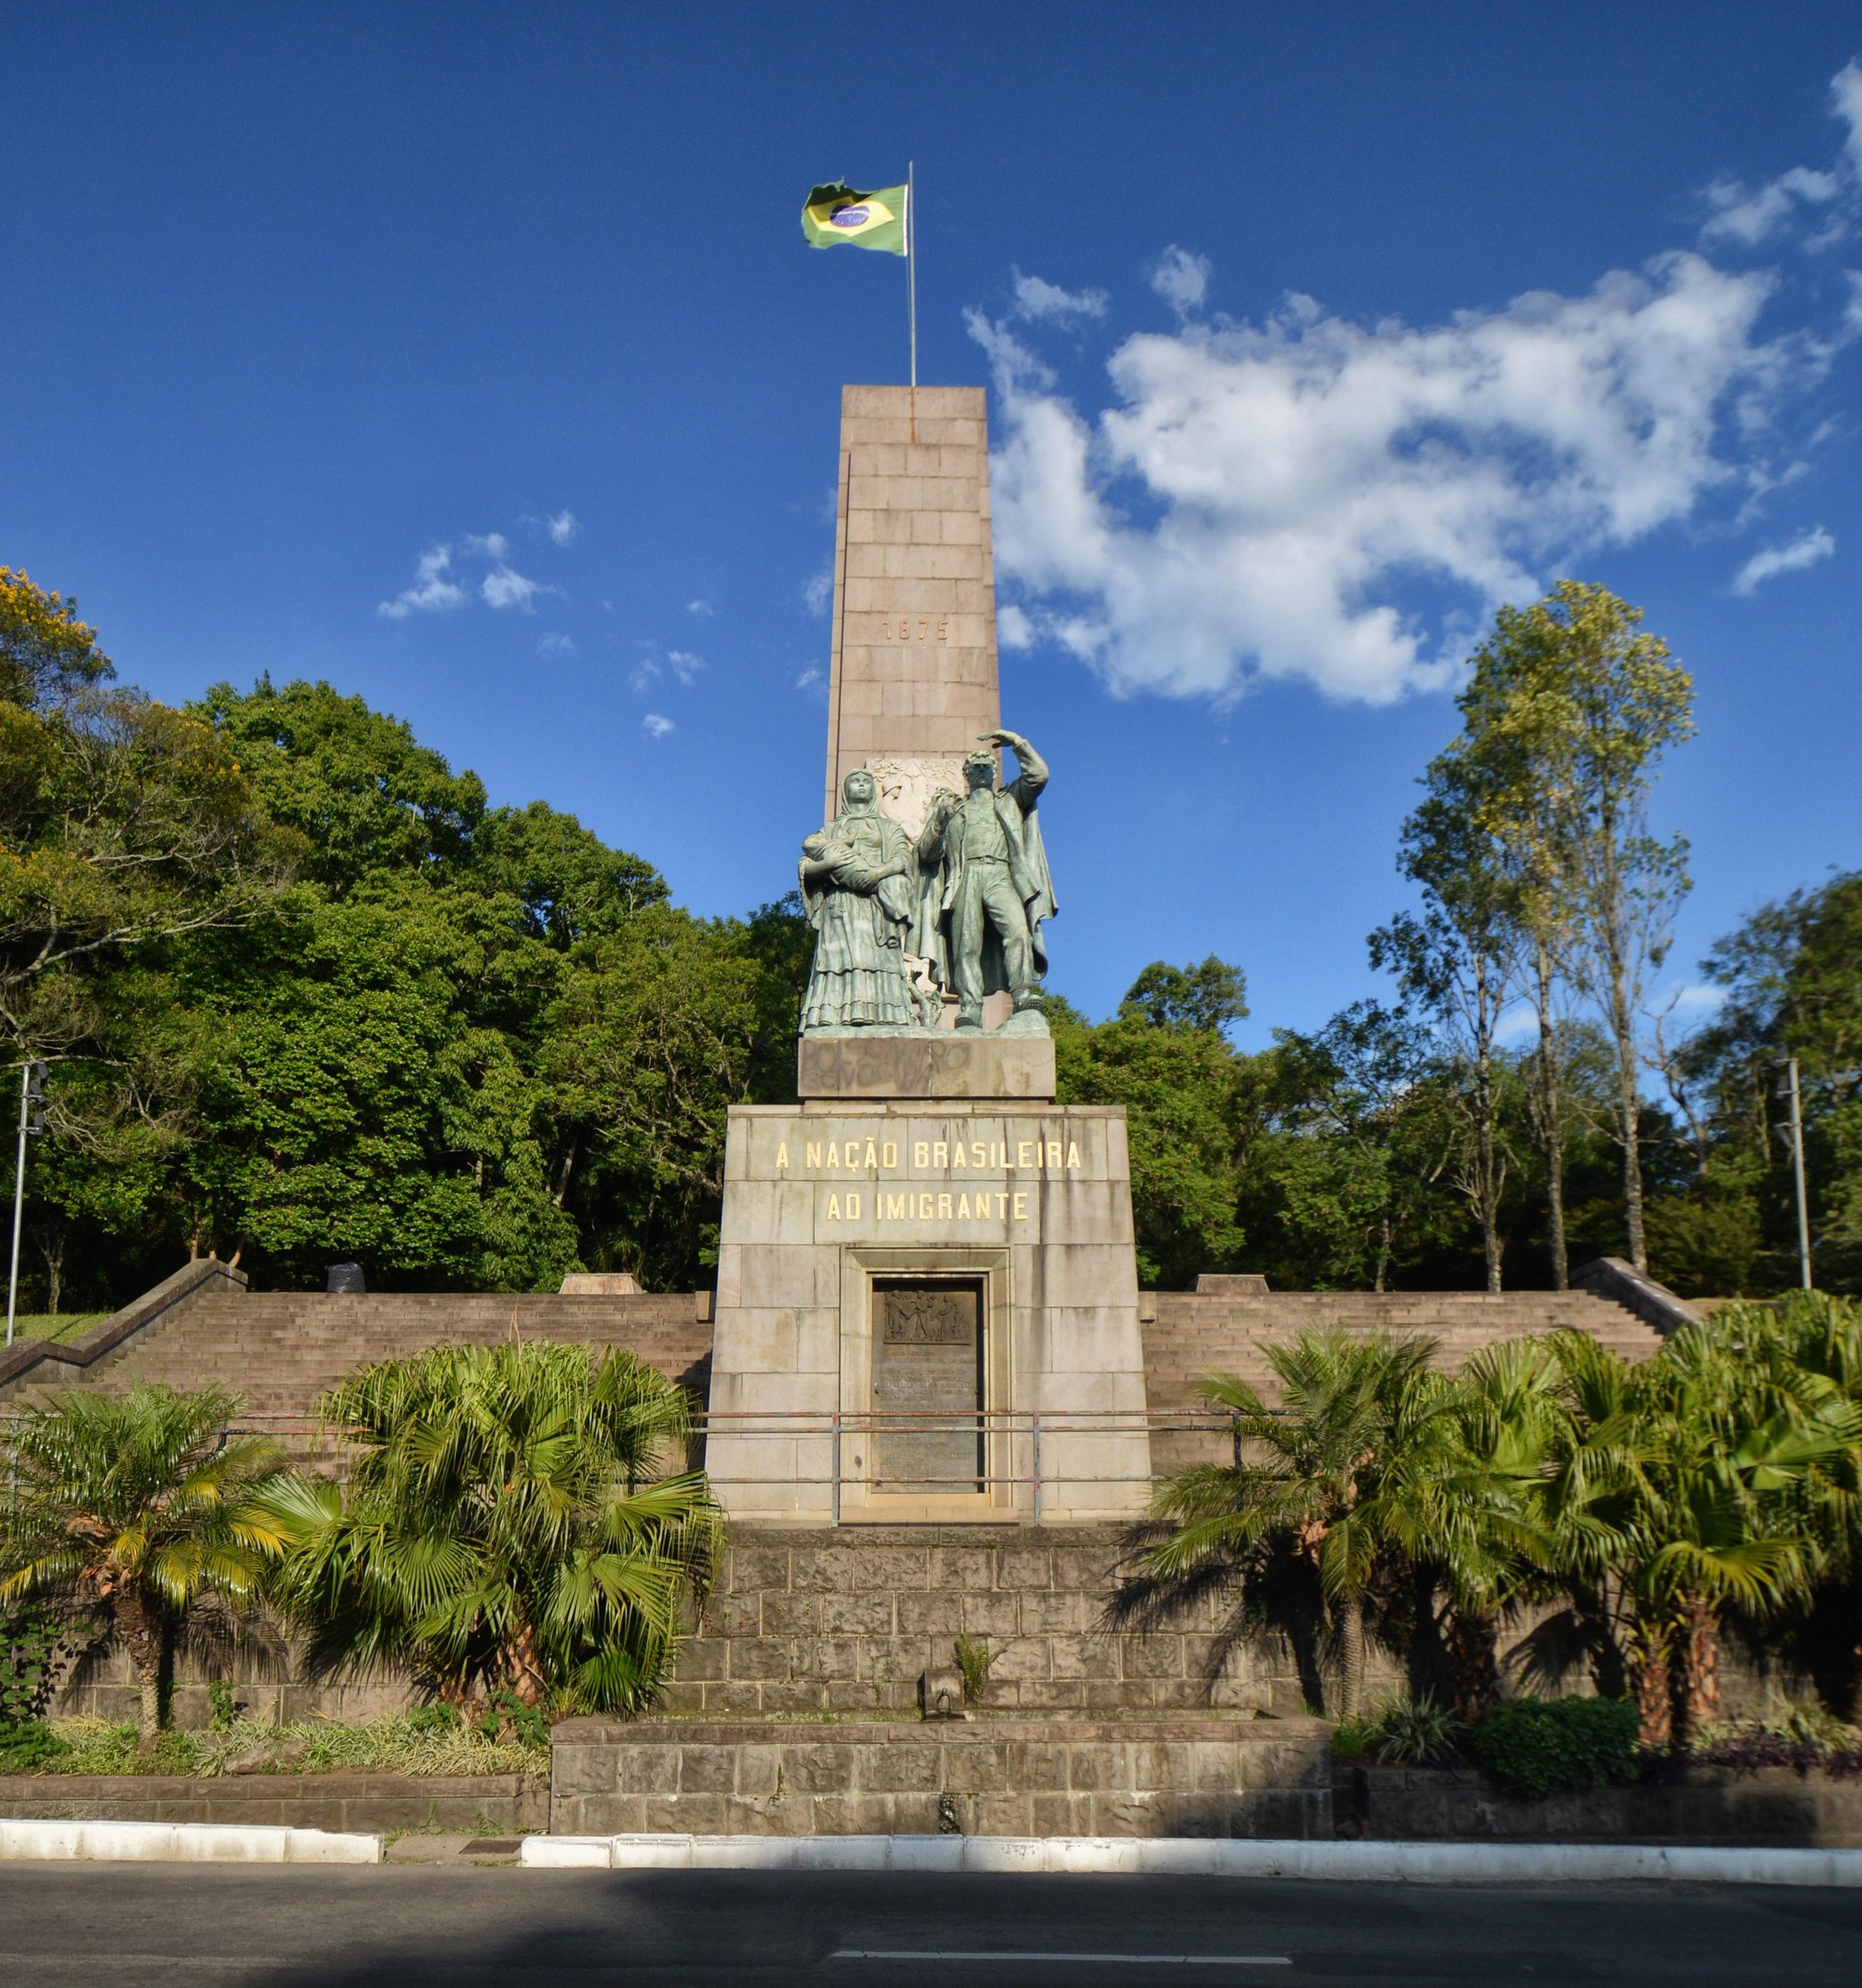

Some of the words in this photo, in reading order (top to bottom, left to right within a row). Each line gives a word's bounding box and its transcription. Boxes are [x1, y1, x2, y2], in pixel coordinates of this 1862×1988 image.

[883, 618, 949, 641] 1875
[775, 1141, 790, 1169] A
[805, 1137, 898, 1173] NAÇÃO
[914, 1141, 1081, 1169] BRASILEIRA
[827, 1193, 862, 1221] AO
[876, 1193, 1029, 1220] IMIGRANTE
